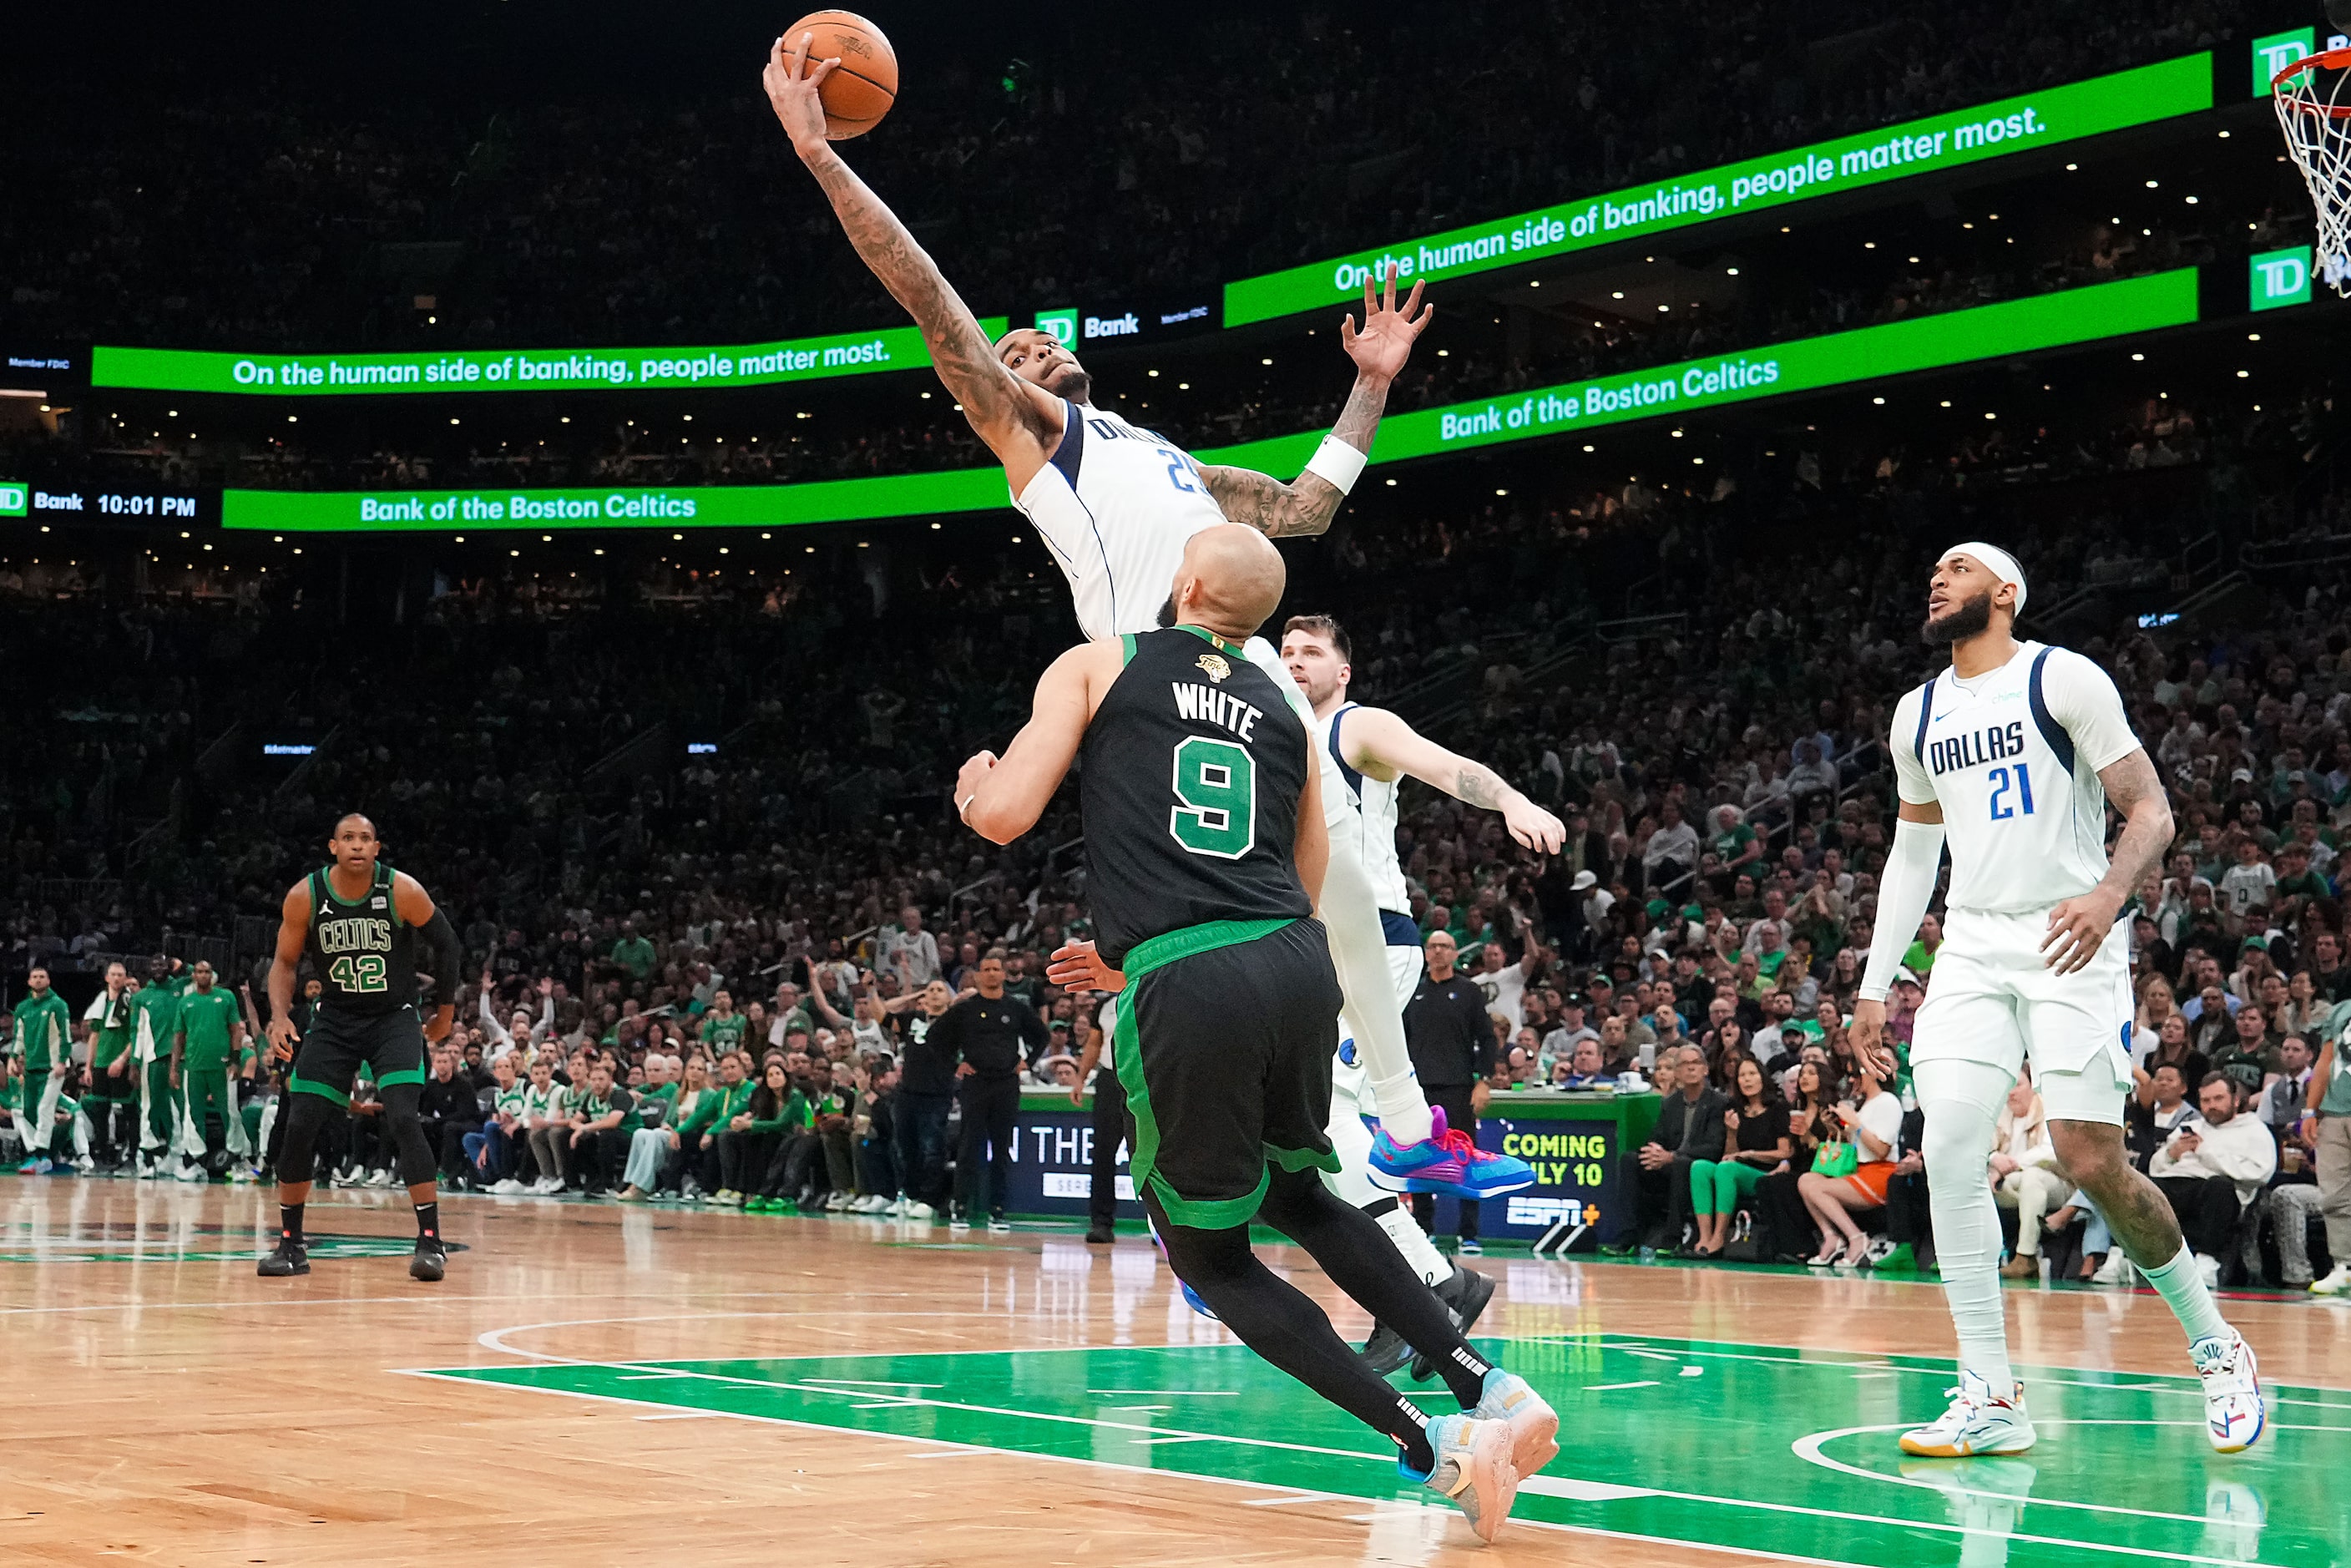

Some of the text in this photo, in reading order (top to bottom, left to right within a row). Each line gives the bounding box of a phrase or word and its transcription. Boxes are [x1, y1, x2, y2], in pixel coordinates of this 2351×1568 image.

[2258, 41, 2308, 82] TD
[1334, 108, 2045, 290] On the human side of banking, people matter most.
[2257, 257, 2305, 297] TD
[1039, 311, 1140, 344] TD Bank
[234, 341, 890, 385] On the human side of banking, people matter most.
[1442, 360, 1777, 440] Bank of the Boston Celtics
[1157, 448, 1210, 495] 2
[34, 492, 83, 511] Bank
[98, 494, 195, 517] 10:01 PM
[361, 495, 695, 520] Bank of the Boston Celtics
[1171, 681, 1263, 744] WHITE
[1929, 721, 2024, 776] DALLAS
[1169, 734, 1256, 861] 9
[1988, 762, 2035, 821] 21
[318, 918, 392, 954] CELTICS
[329, 954, 388, 993] 42
[1031, 1126, 1095, 1165] THE
[1502, 1133, 1606, 1159] COMING
[1529, 1161, 1603, 1186] LY 10
